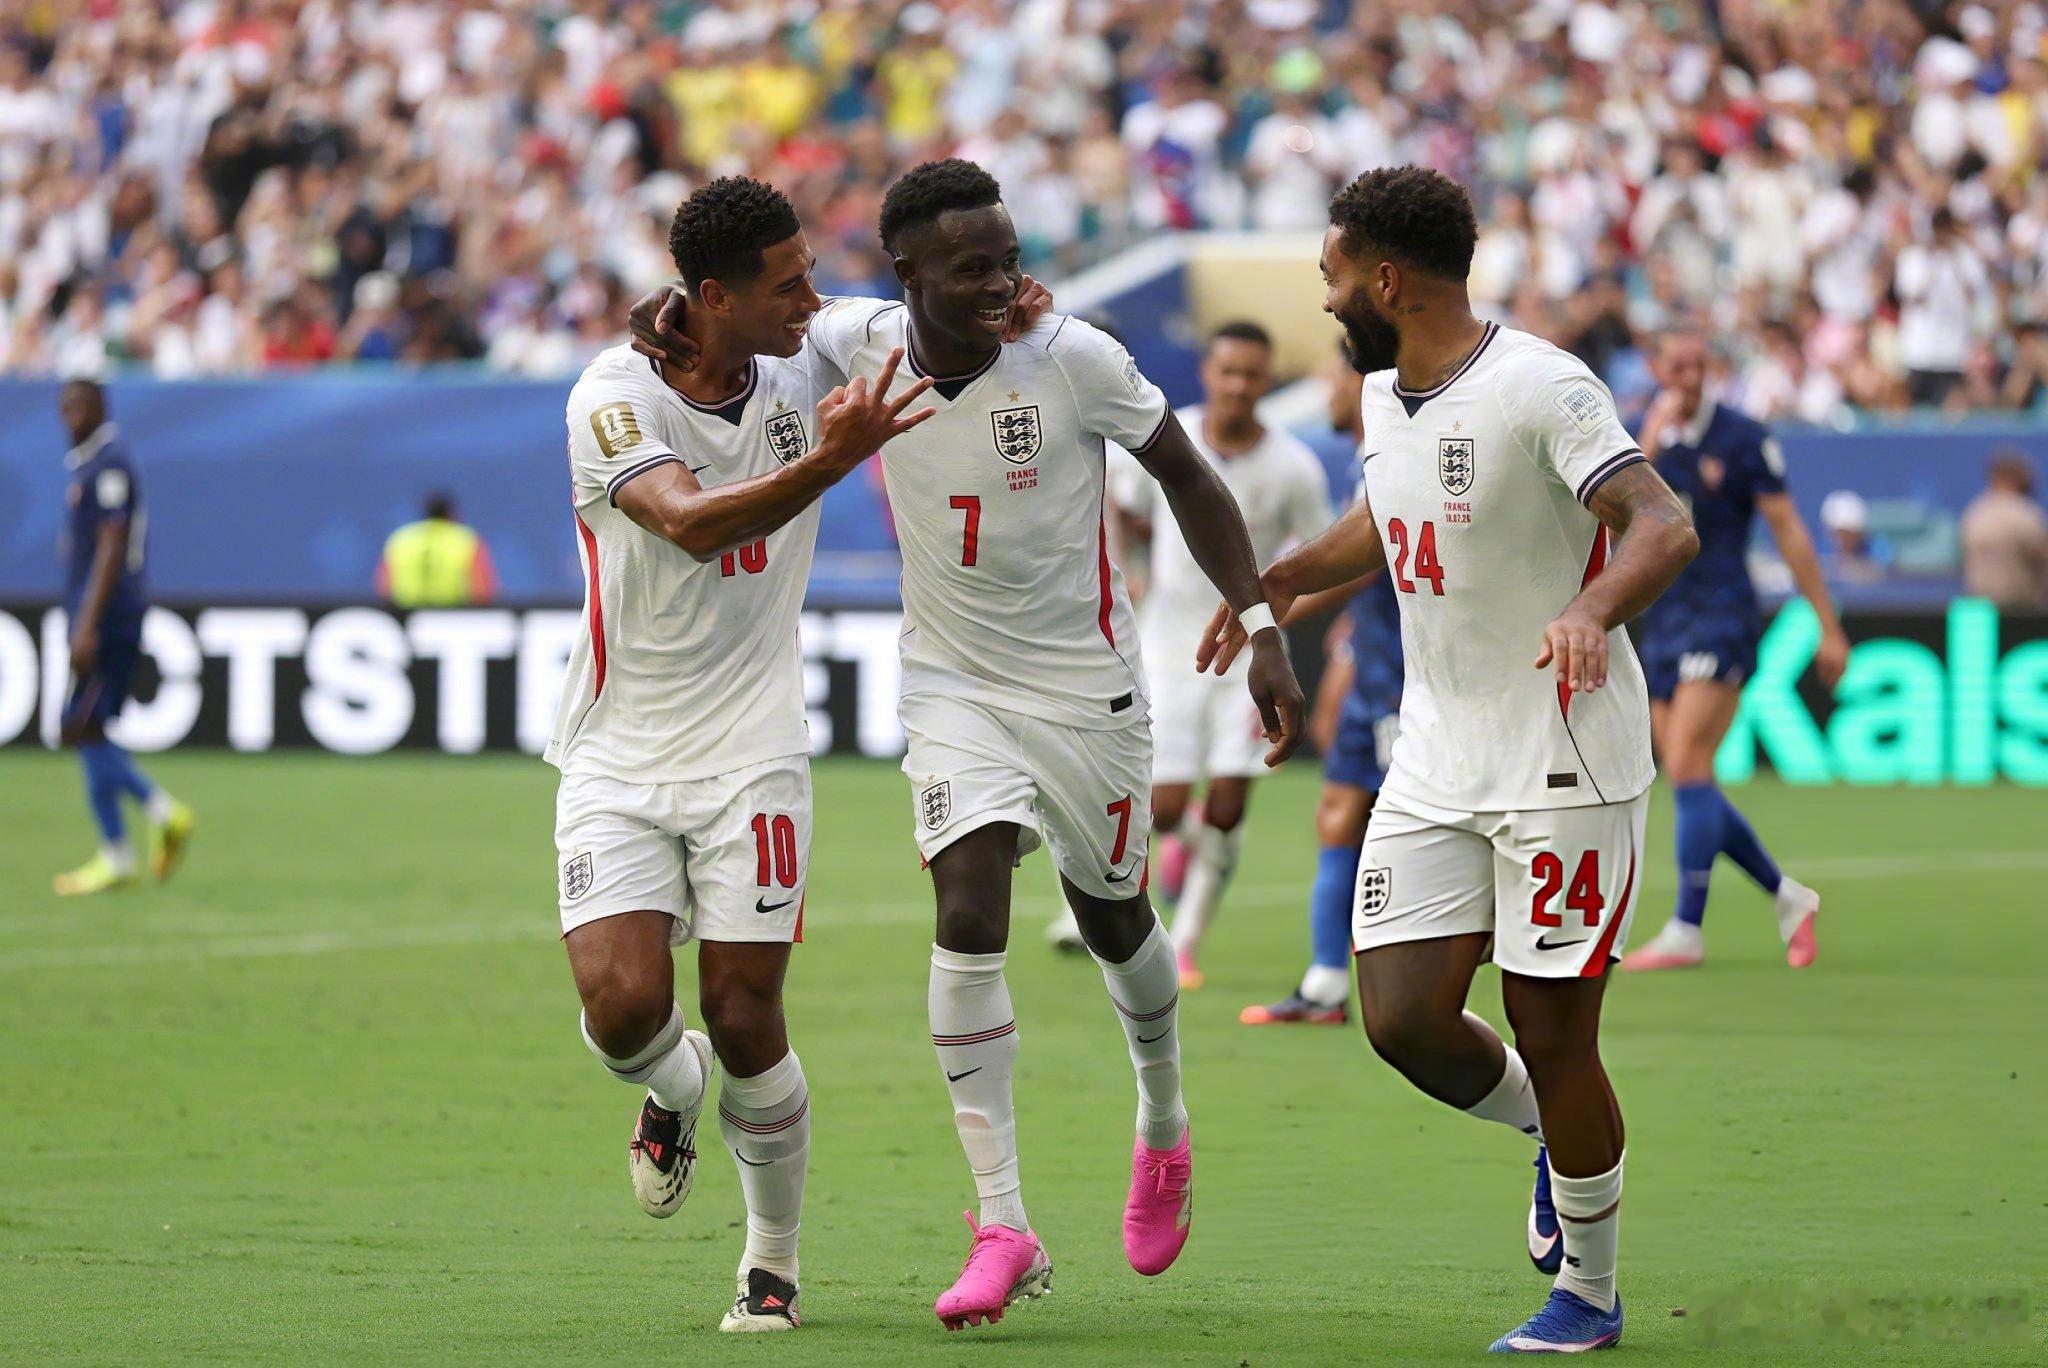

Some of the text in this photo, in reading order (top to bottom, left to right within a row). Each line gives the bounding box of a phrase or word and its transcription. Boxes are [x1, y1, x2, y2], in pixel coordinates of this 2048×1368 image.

[1569, 391, 1595, 413] UNITES
[1006, 467, 1038, 481] FRANCE
[1009, 479, 1038, 492] 18.07.26
[1444, 502, 1472, 512] FRANCE
[950, 495, 981, 567] 7
[1388, 518, 1445, 596] 24
[751, 812, 797, 889] 10
[1106, 794, 1131, 866] 7
[1531, 849, 1604, 927] 24
